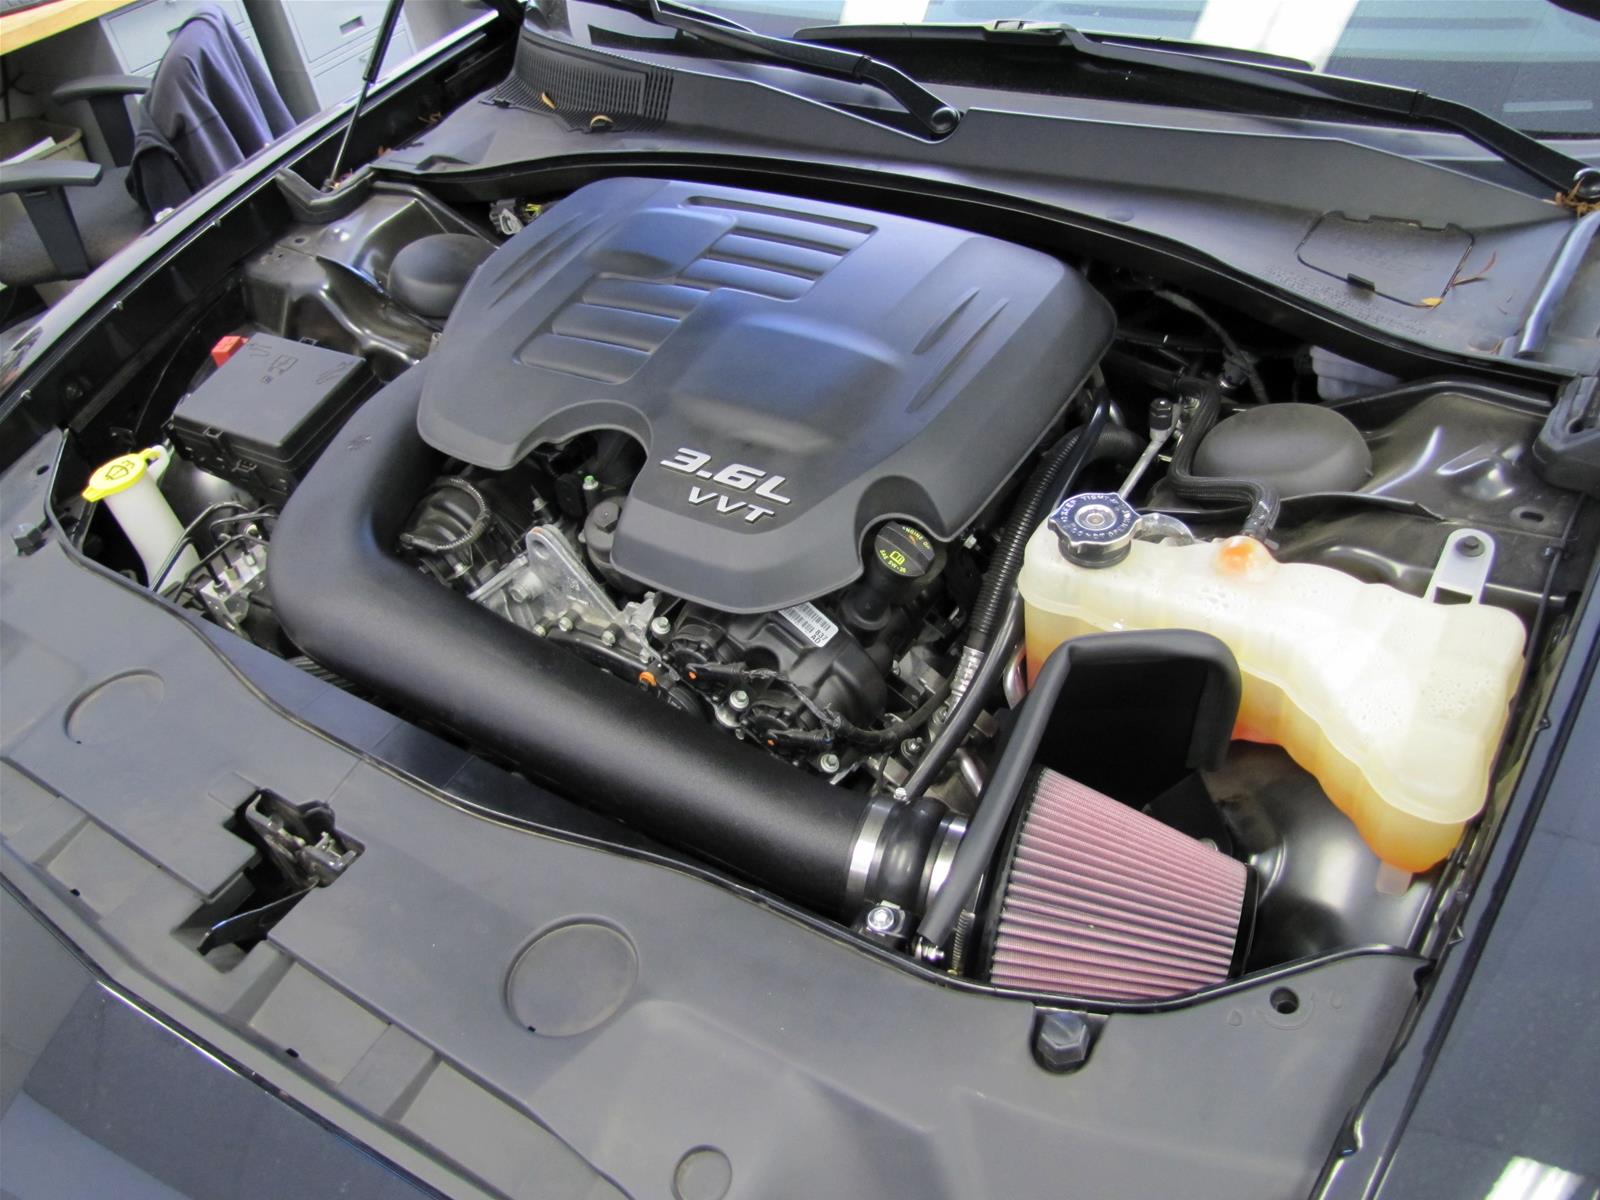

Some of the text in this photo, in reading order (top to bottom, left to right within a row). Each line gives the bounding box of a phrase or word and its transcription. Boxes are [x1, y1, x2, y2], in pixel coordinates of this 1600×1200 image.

[660, 447, 791, 505] 3.6L
[688, 486, 776, 523] VVT
[902, 526, 924, 540] ENGINE
